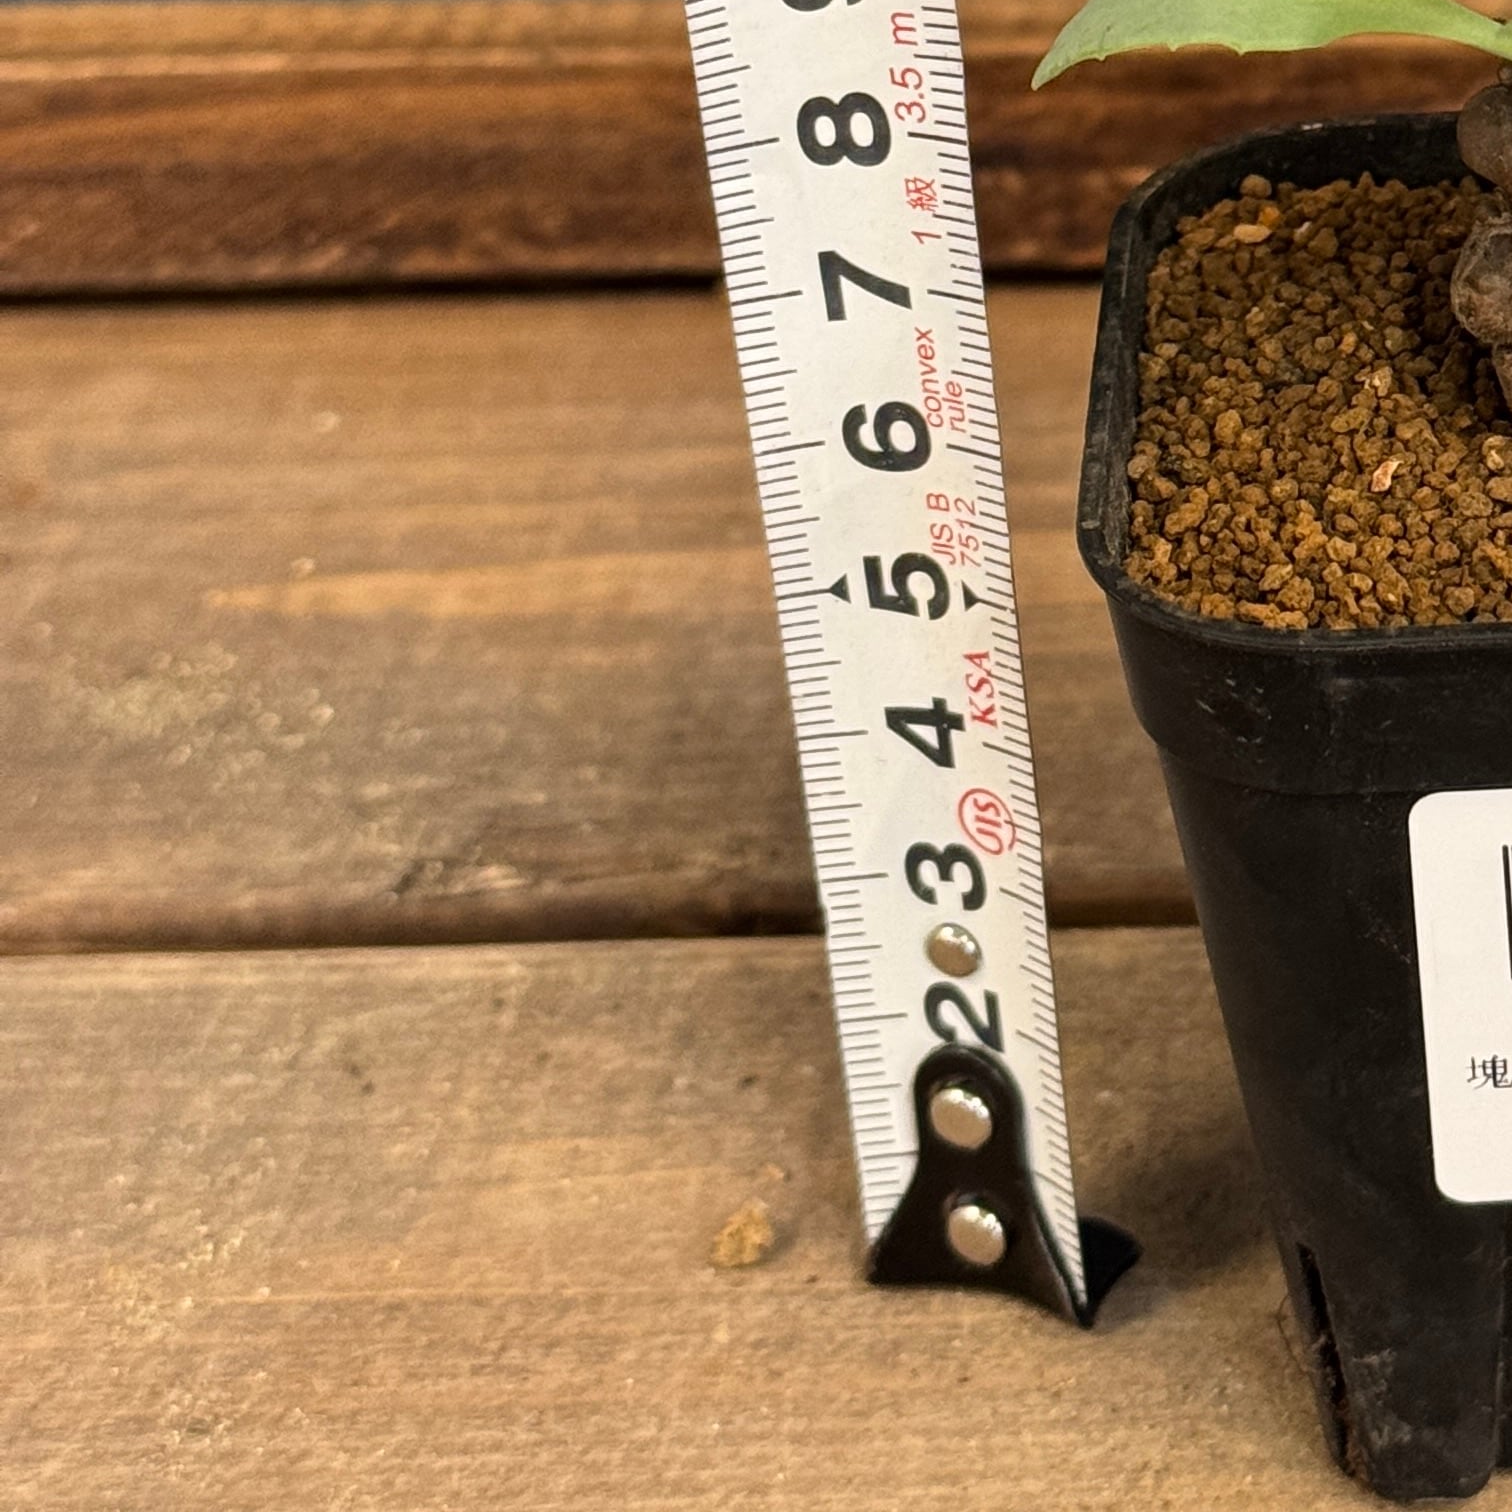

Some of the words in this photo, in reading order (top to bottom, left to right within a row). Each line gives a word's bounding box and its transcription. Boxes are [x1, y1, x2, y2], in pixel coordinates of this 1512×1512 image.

[890, 11, 918, 46] m
[796, 92, 891, 167] 8
[889, 66, 926, 122] 3.5
[817, 250, 912, 322] 7
[914, 327, 945, 428] convex
[945, 380, 967, 433] rule
[842, 401, 932, 472] 6
[926, 492, 950, 512] B
[953, 497, 982, 567] 7512
[929, 522, 957, 565] JIS
[863, 552, 950, 621] 5
[963, 651, 998, 727] KSA
[884, 697, 966, 769] 4
[904, 841, 987, 912] 3
[924, 981, 1005, 1053] 2
